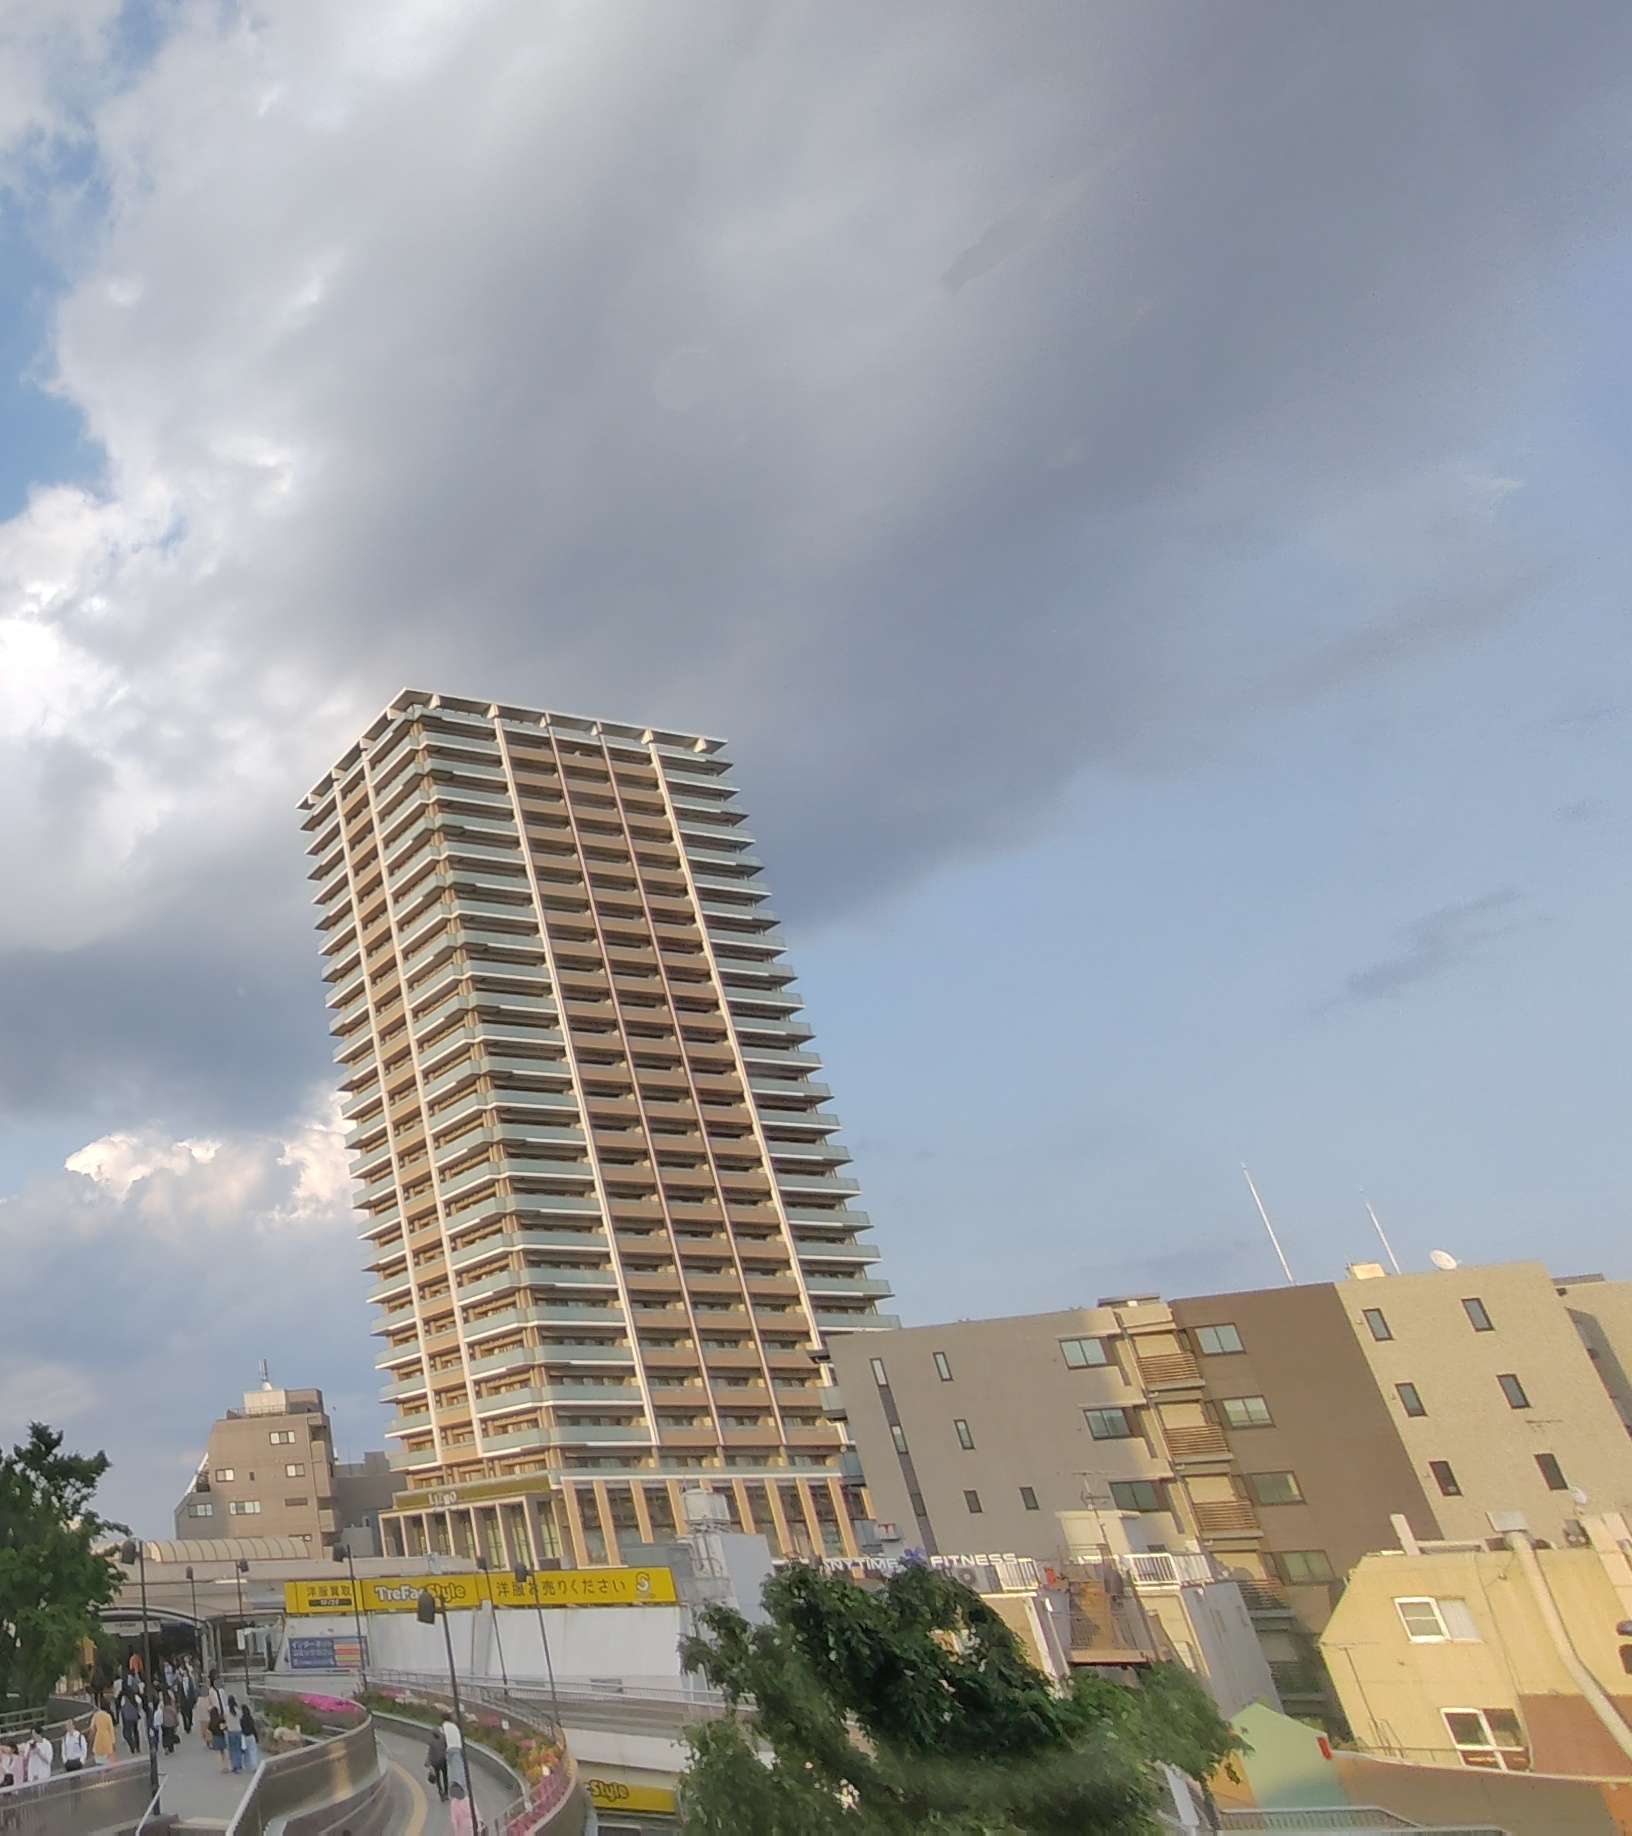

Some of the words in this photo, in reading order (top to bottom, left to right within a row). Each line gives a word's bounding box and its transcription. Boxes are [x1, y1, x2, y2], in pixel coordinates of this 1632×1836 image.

[929, 1553, 1019, 1567] FITNESS
[306, 1584, 352, 1598] 洋服買取
[496, 1578, 626, 1597] 洋服お売りください
